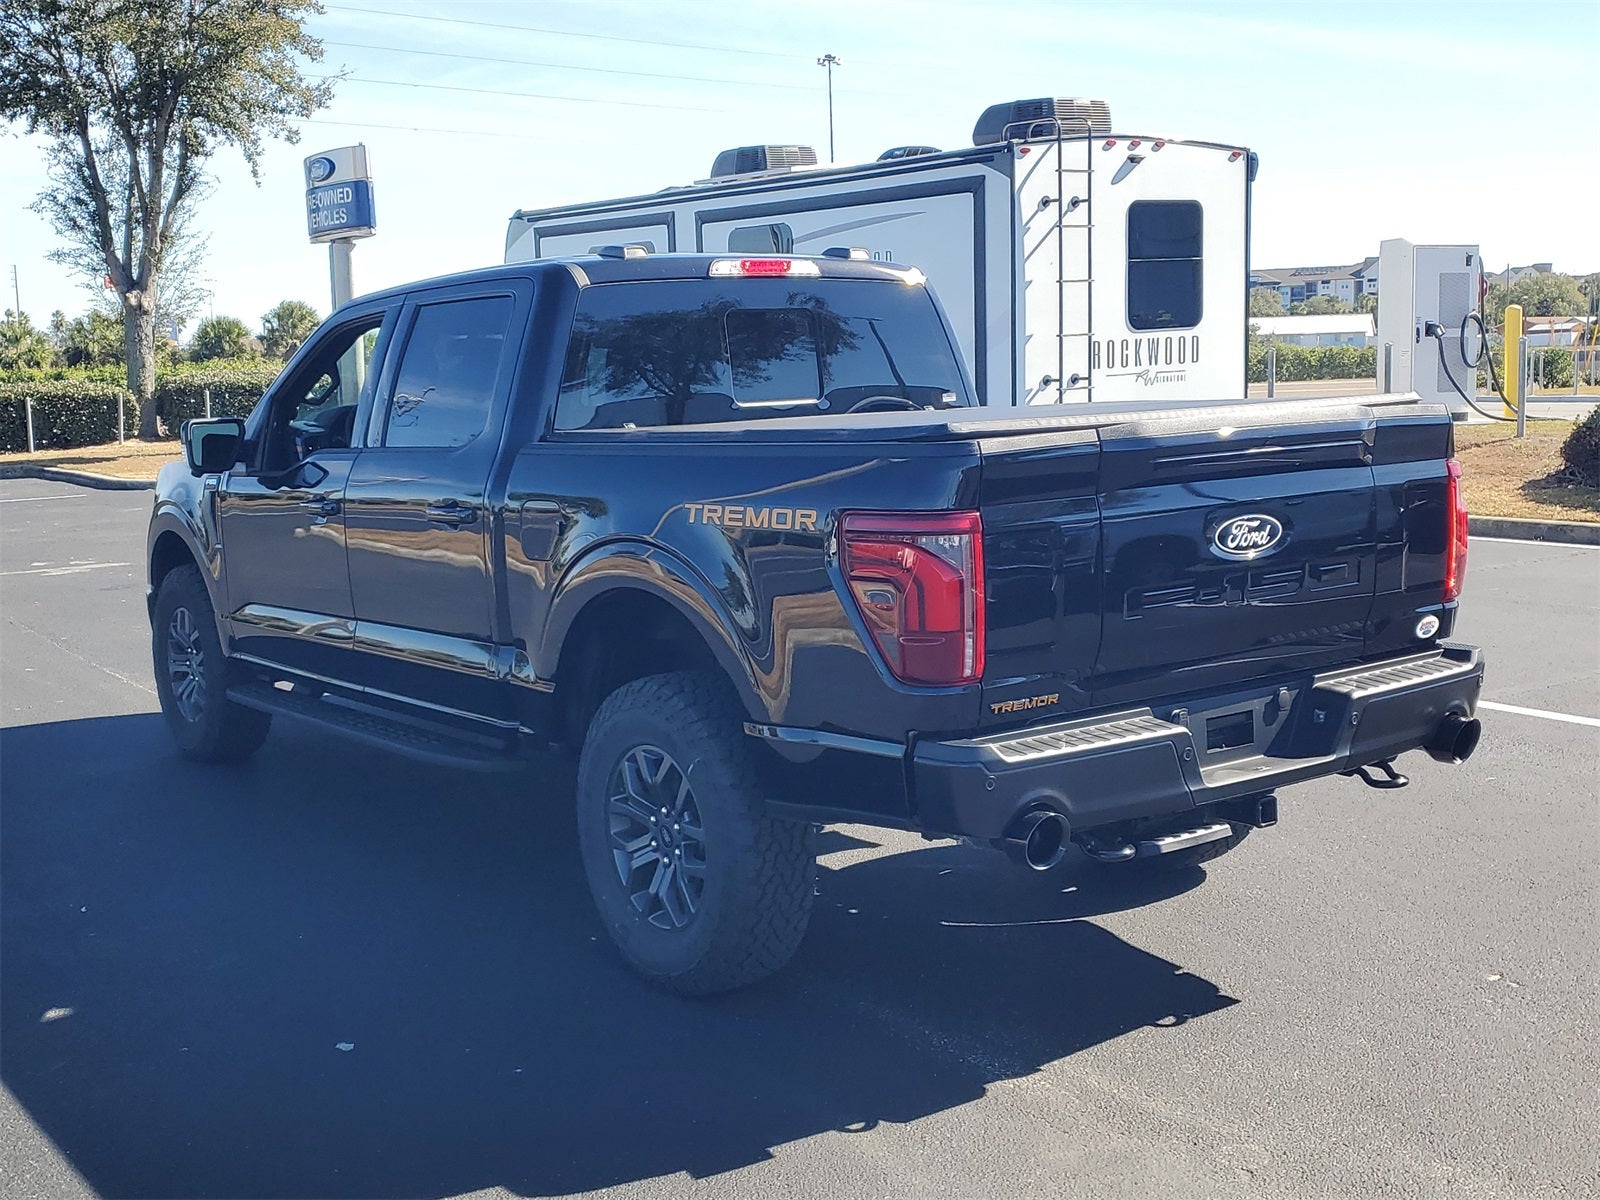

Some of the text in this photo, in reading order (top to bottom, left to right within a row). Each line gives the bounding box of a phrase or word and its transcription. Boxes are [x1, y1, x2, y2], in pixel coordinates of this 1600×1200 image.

[1092, 335, 1199, 370] ROCKWOOD
[684, 503, 817, 531] TREMOR
[1227, 520, 1271, 548] Ford
[990, 693, 1059, 715] TREMOR
